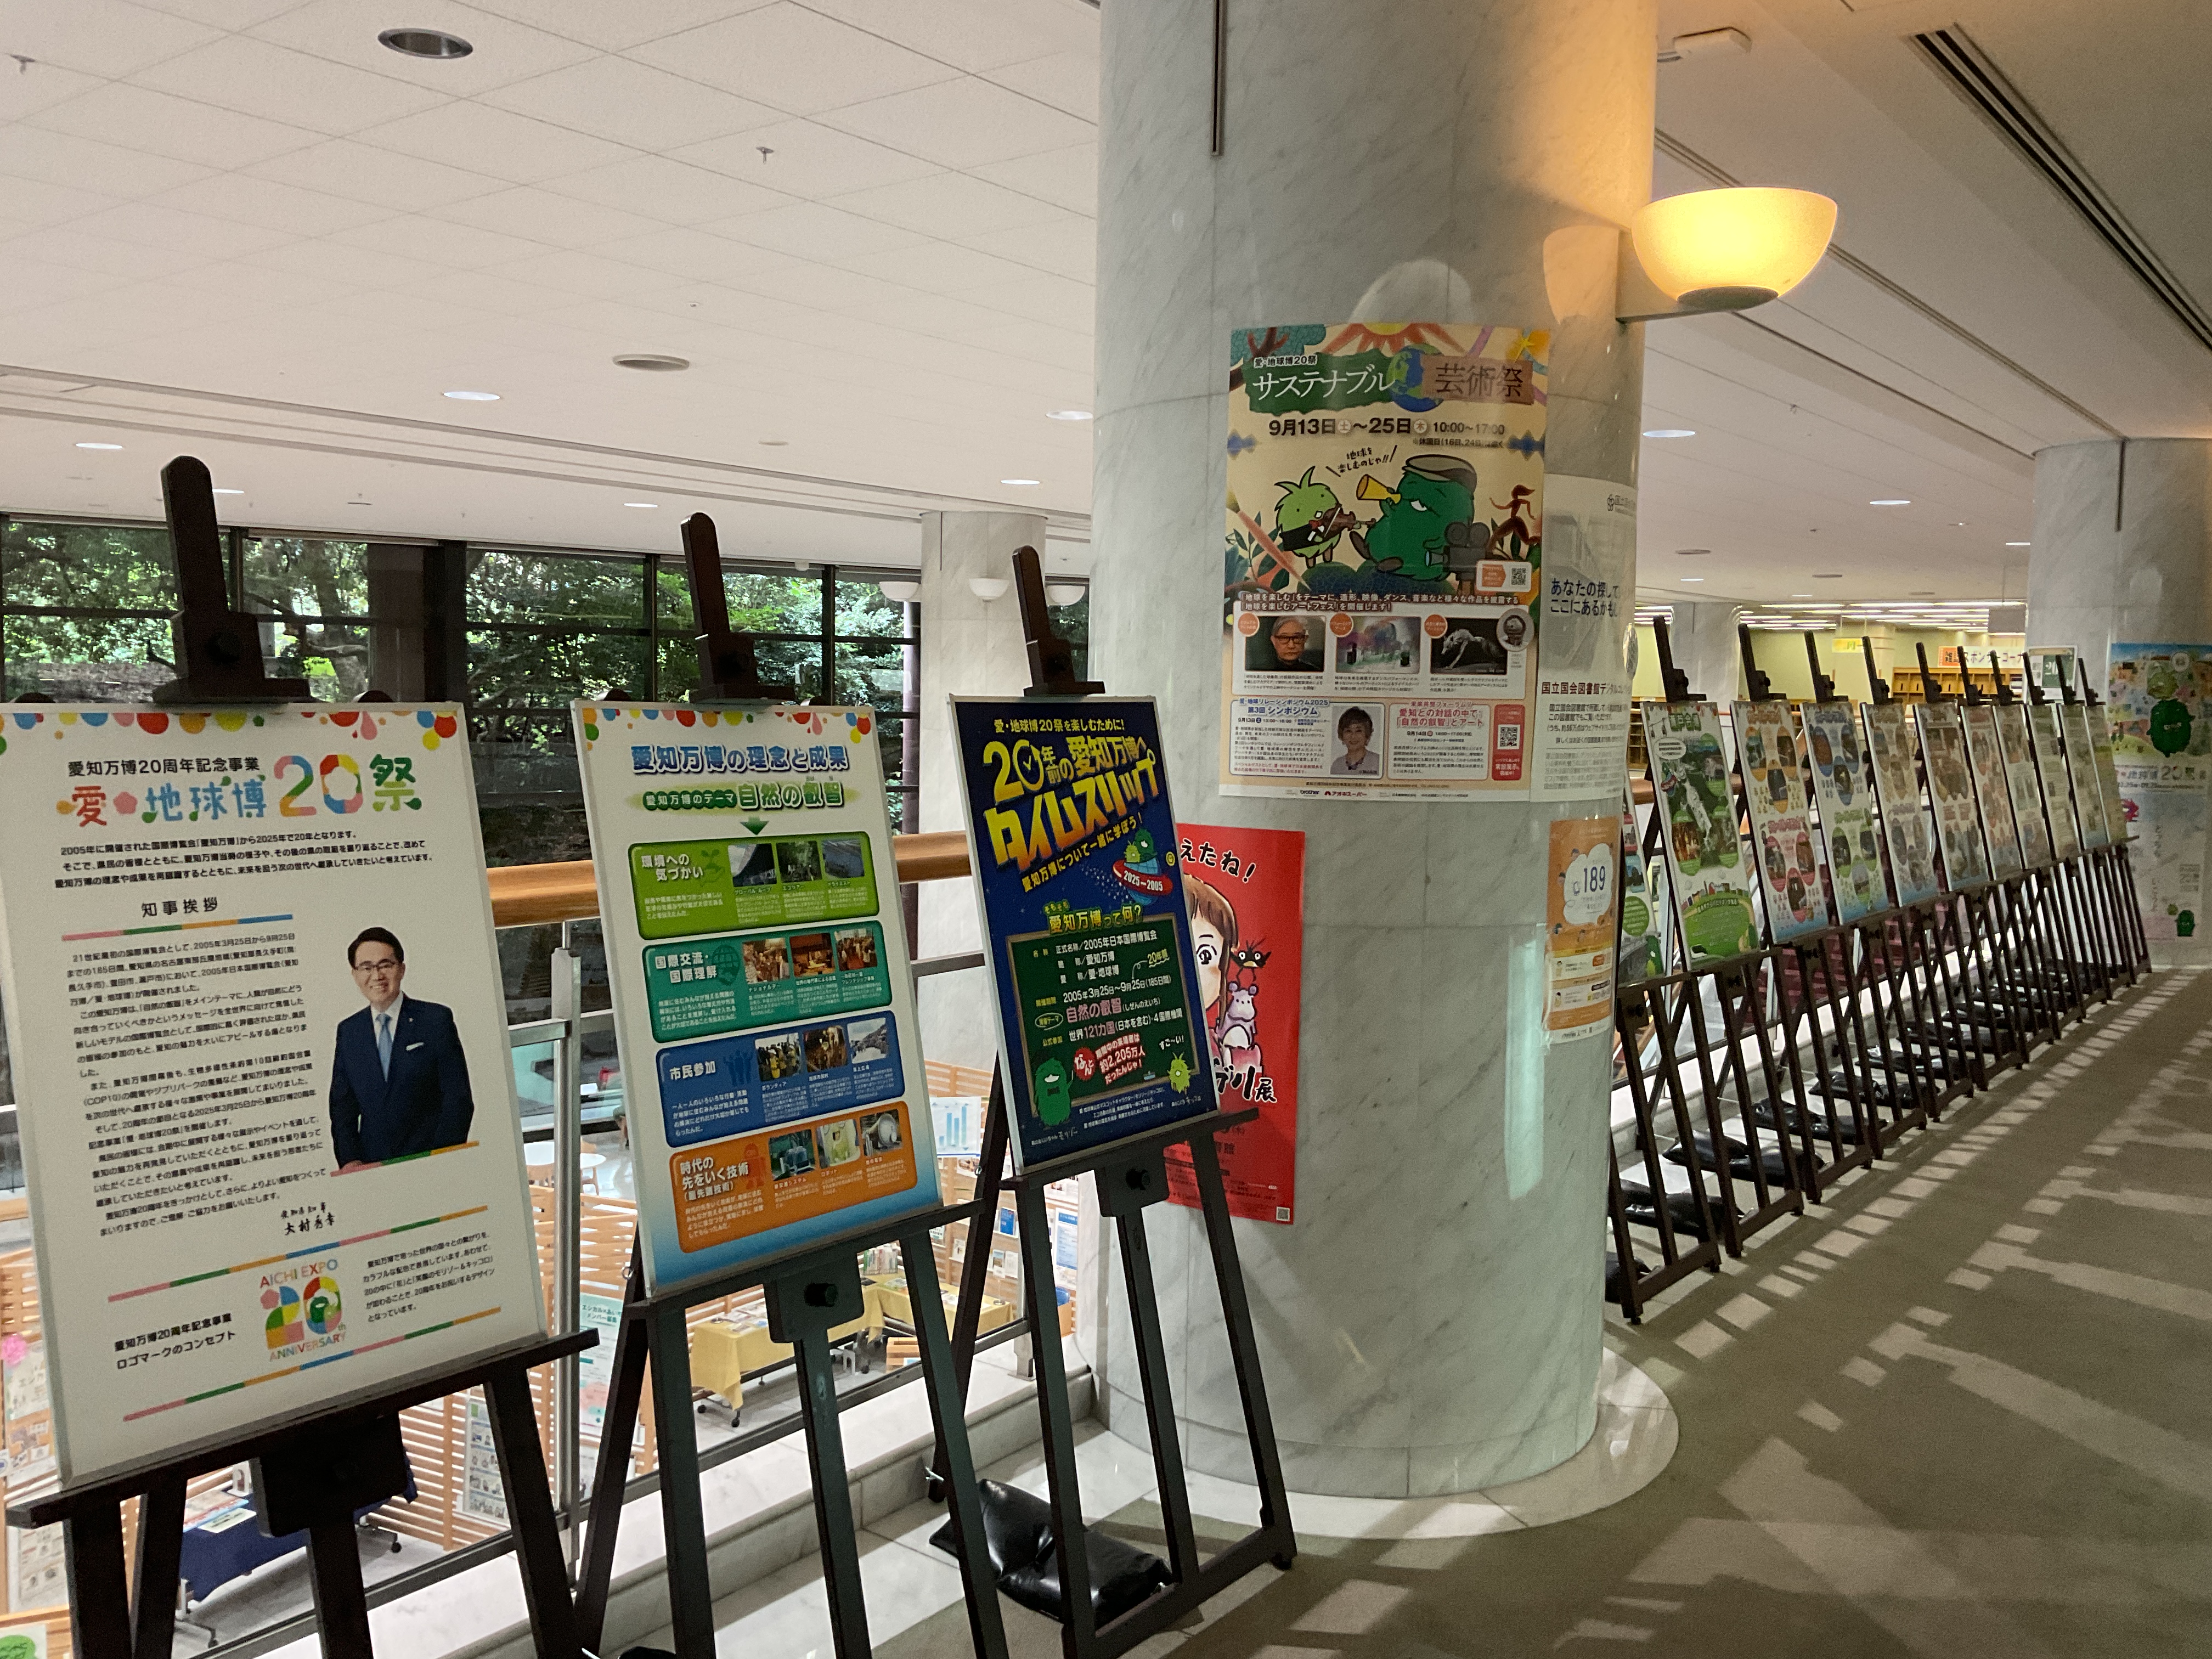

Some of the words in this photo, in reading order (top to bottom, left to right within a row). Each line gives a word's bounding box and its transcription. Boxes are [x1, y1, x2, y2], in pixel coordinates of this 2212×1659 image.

[1252, 364, 1396, 400] サステナブル
[1435, 363, 1523, 397] 芸術祭
[1268, 706, 1318, 715] シンポジウム
[1396, 718, 1483, 727] 「自然の叡智」とアート
[68, 757, 259, 777] 愛知万博20周年記念事業
[631, 744, 850, 774] 愛知万博の理念と成果
[645, 792, 734, 807] 愛知万博のテーマ
[738, 781, 844, 809] 自然の叡智
[984, 749, 1159, 871] タイムスリップ
[641, 854, 690, 867] 環境への
[656, 867, 704, 882] 気づかい
[1584, 866, 1605, 893] 189
[141, 897, 218, 917] 知事挨拶
[669, 965, 718, 983] 国際理解
[1066, 997, 1121, 1023] 自然の叡智
[669, 1061, 716, 1081] 市民参加
[1074, 1054, 1094, 1076] なんと
[1099, 1046, 1146, 1073] 約2,205万人
[1213, 1058, 1277, 1103] ブリ展
[680, 1157, 714, 1175] 時代の
[682, 1161, 749, 1191] 先をいく技術
[260, 1268, 298, 1289] AICHI
[301, 1259, 338, 1278] EXPO
[368, 1304, 416, 1322] となっています。
[115, 1313, 233, 1352] 愛知万博20周年記念事業
[117, 1331, 237, 1369] ロゴマークのコンセプト
[270, 1332, 346, 1362] ANNIVERSARY
